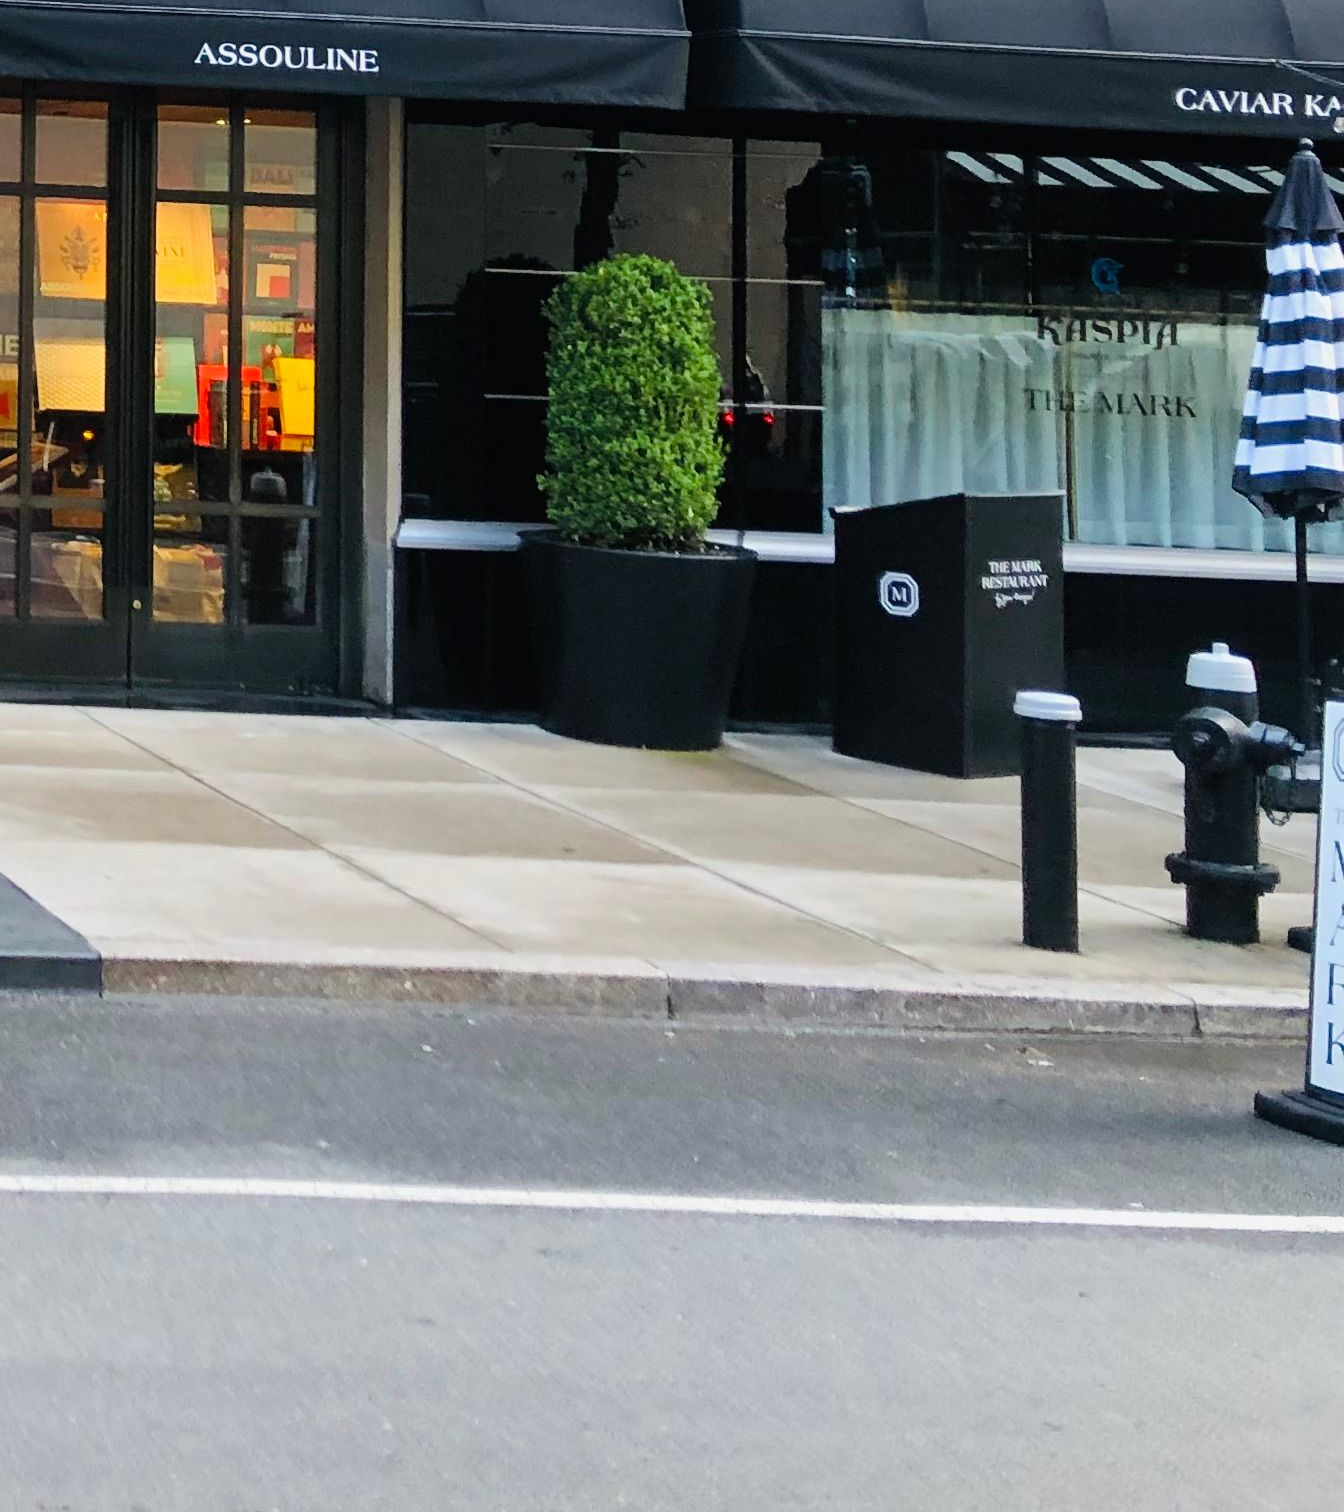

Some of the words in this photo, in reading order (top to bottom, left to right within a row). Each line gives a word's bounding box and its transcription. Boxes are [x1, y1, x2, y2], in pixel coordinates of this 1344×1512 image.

[194, 42, 380, 73] ASSOULINE
[1175, 87, 1295, 116] CAVIAR
[1037, 317, 1181, 350] KASPIA
[1024, 389, 1091, 413] THE
[1097, 391, 1198, 418] MARK
[988, 560, 1010, 573] THE
[1011, 559, 1043, 573] MARK
[981, 574, 1049, 589] RESTAURANT
